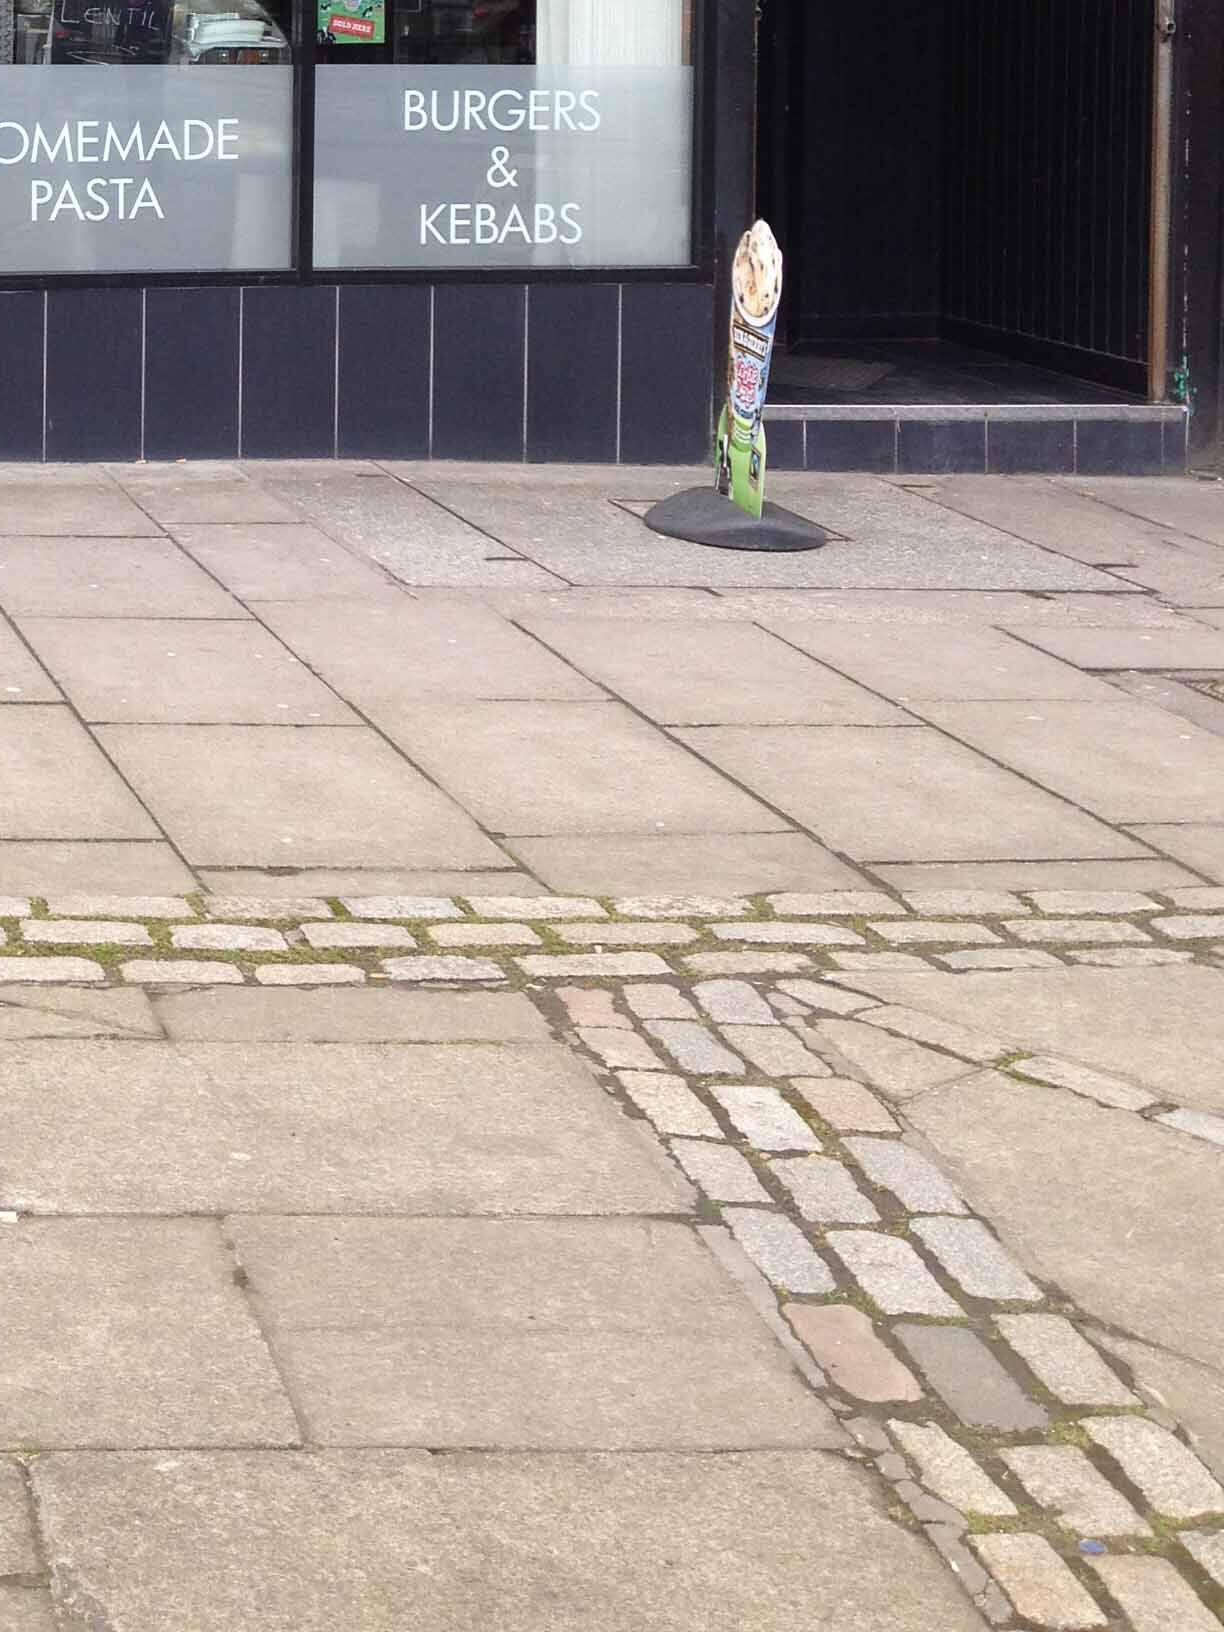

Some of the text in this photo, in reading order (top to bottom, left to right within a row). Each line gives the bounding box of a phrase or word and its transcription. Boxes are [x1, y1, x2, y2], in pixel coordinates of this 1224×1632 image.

[403, 89, 601, 131] BURGERS
[486, 145, 519, 188] &
[30, 177, 166, 222] PASTA
[419, 202, 583, 245] KEBABS
